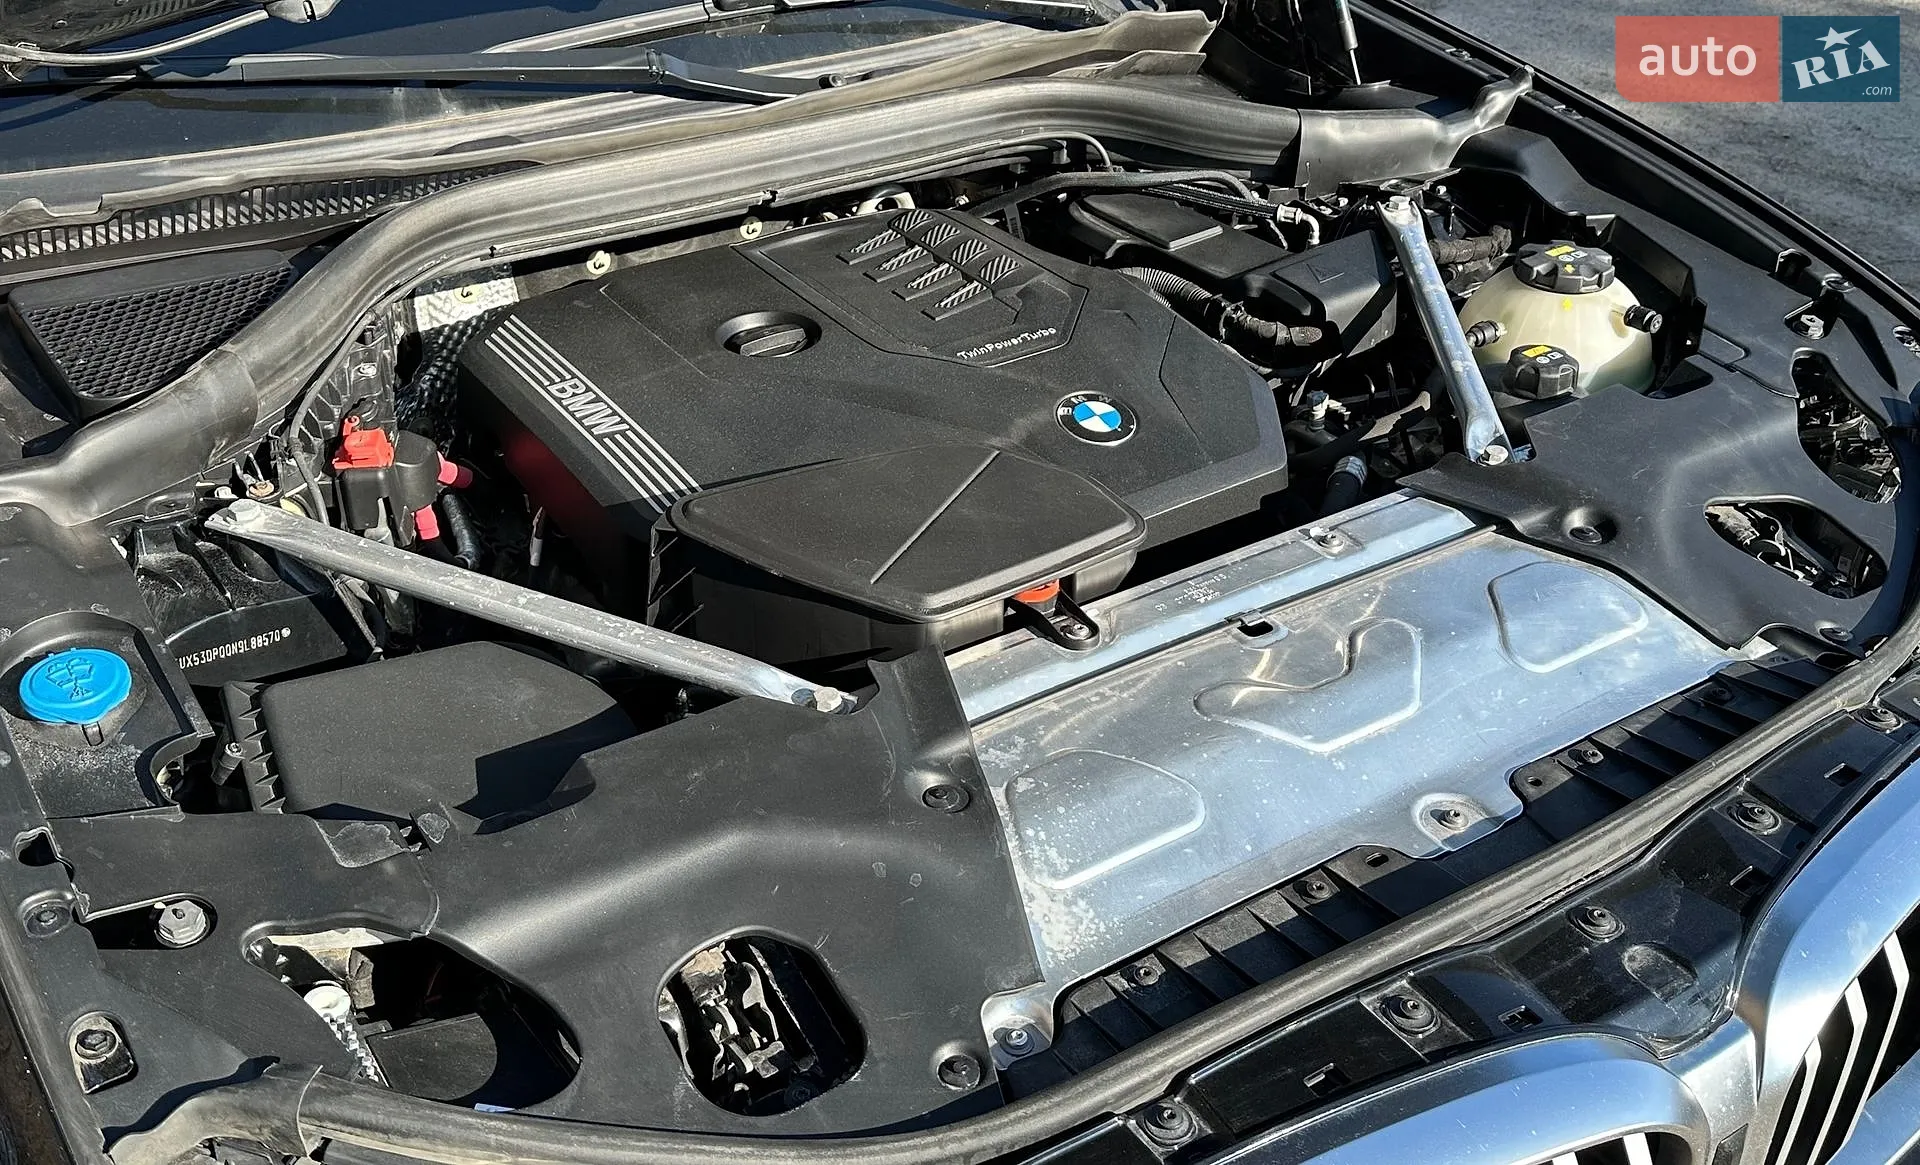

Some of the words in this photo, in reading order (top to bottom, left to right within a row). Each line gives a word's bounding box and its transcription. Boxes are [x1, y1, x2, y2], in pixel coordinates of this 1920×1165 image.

[956, 327, 1057, 360] TwinPowerTurbo
[546, 377, 631, 436] BMW
[1059, 394, 1114, 417] BMW
[176, 629, 281, 670] UX53DP00N9L88570
